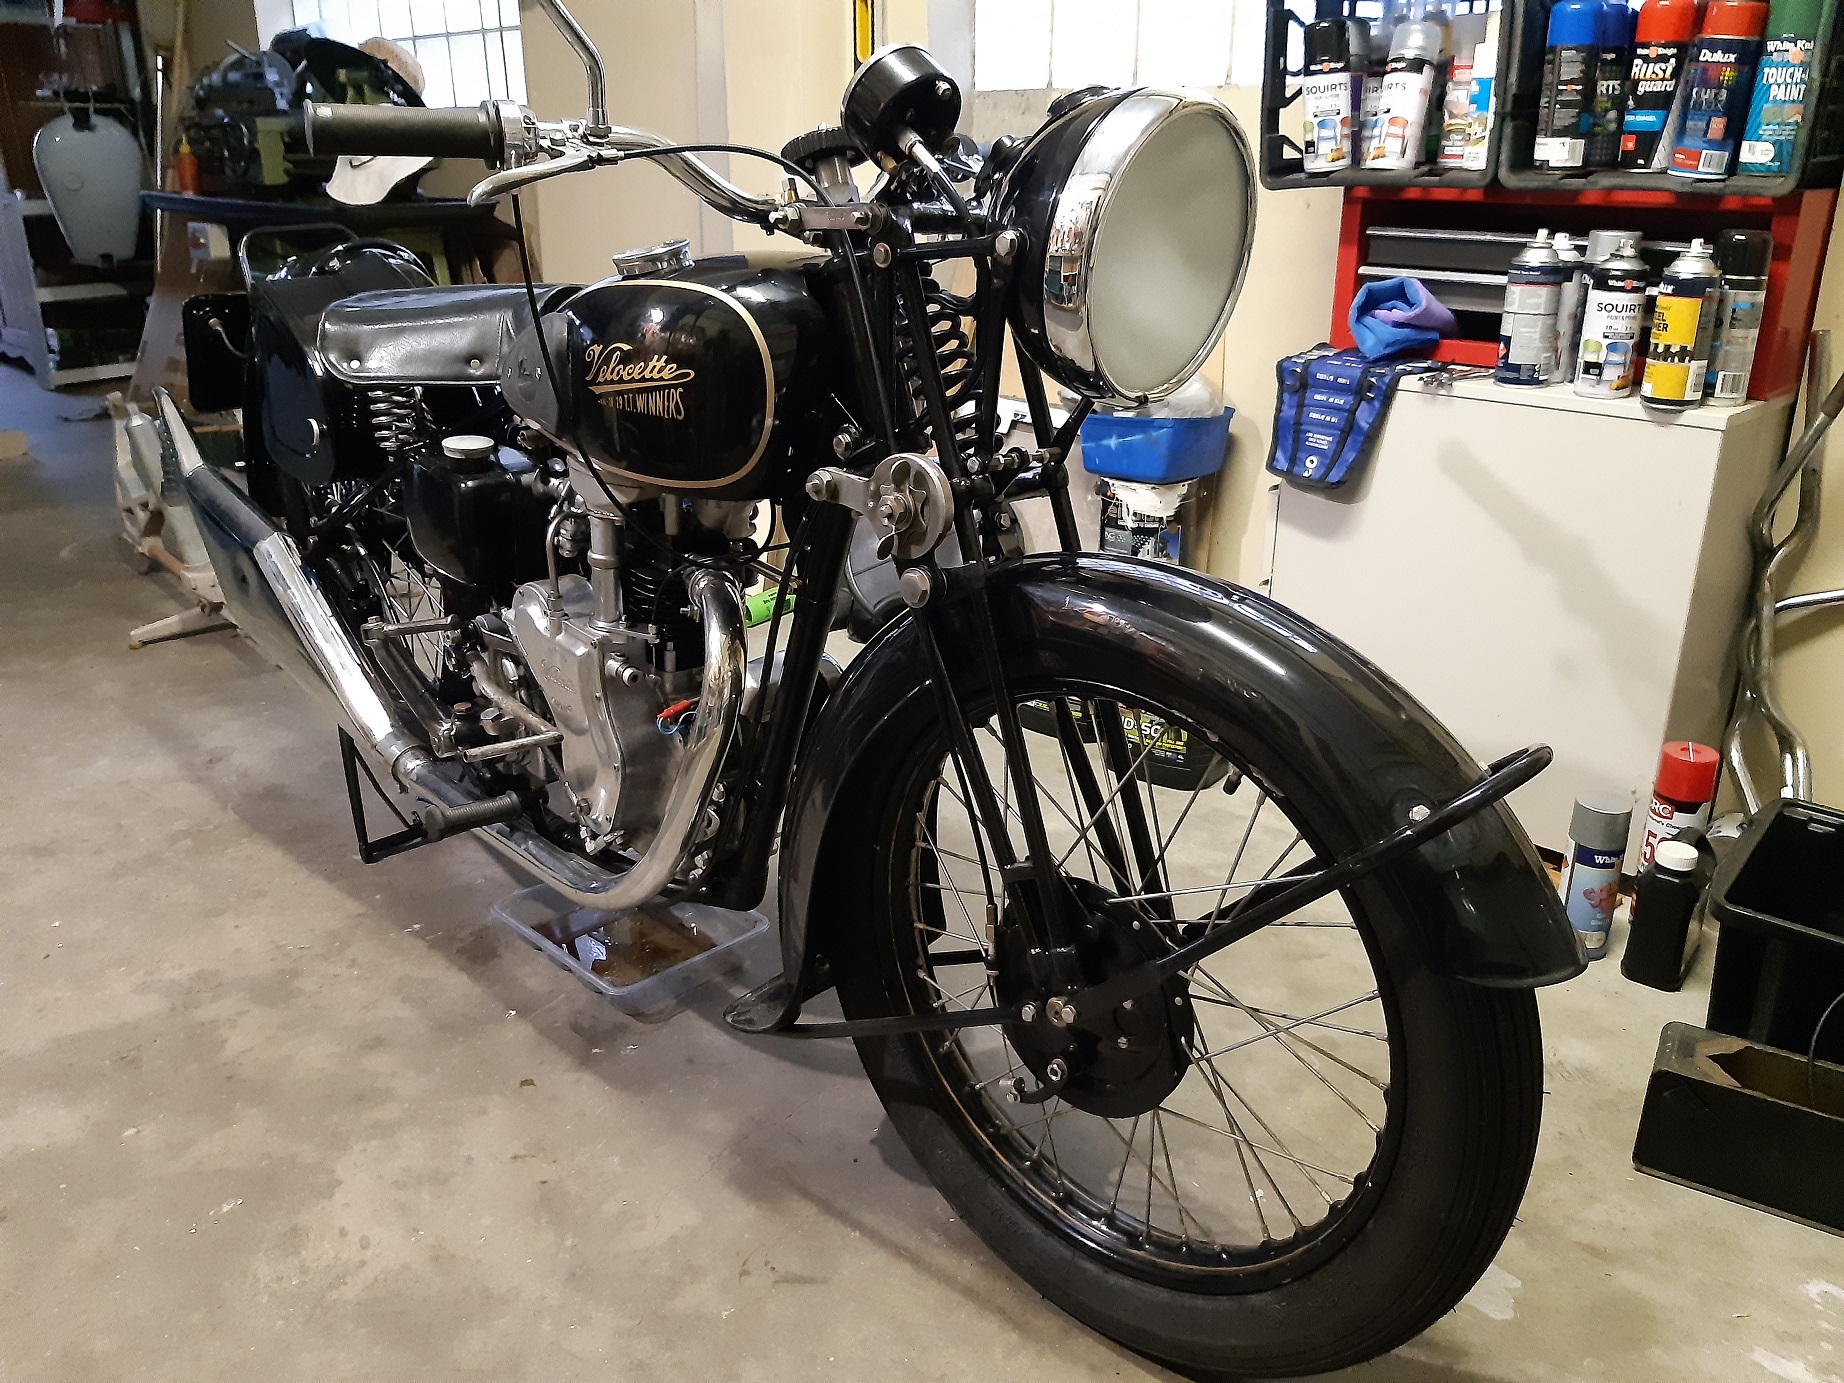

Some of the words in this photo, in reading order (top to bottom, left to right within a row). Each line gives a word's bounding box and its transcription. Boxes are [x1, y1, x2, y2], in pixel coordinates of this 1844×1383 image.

[1699, 49, 1737, 62] Dulux
[1631, 58, 1676, 80] Rust
[1305, 82, 1348, 95] SQUIRTS
[1637, 79, 1675, 95] guard
[1769, 84, 1806, 101] PAINT
[1596, 302, 1644, 314] SQUIRT
[585, 342, 694, 384] Velocette
[636, 387, 685, 420] WINNERS
[1651, 798, 1672, 817] RC
